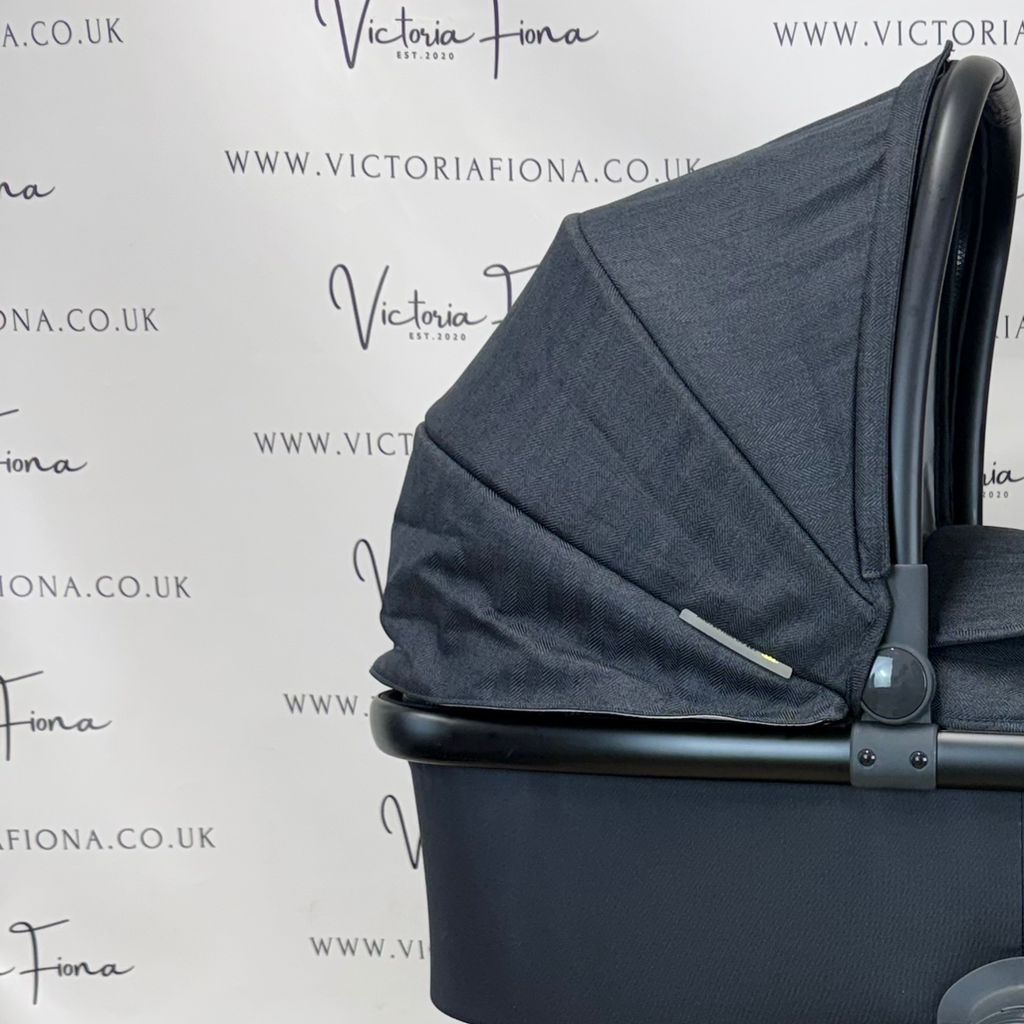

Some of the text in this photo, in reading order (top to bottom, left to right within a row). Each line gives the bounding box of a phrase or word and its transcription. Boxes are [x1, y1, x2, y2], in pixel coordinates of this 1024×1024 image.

[2, 17, 124, 48] A.CO.UK
[315, 0, 475, 69] Victoria
[396, 47, 455, 61] EST.2020
[224, 150, 701, 183] WWW.VICTORIAFIONA.CO.UK
[329, 263, 488, 351] Victoria
[408, 328, 467, 342] EST.2020
[9, 919, 135, 1005] Fiona
